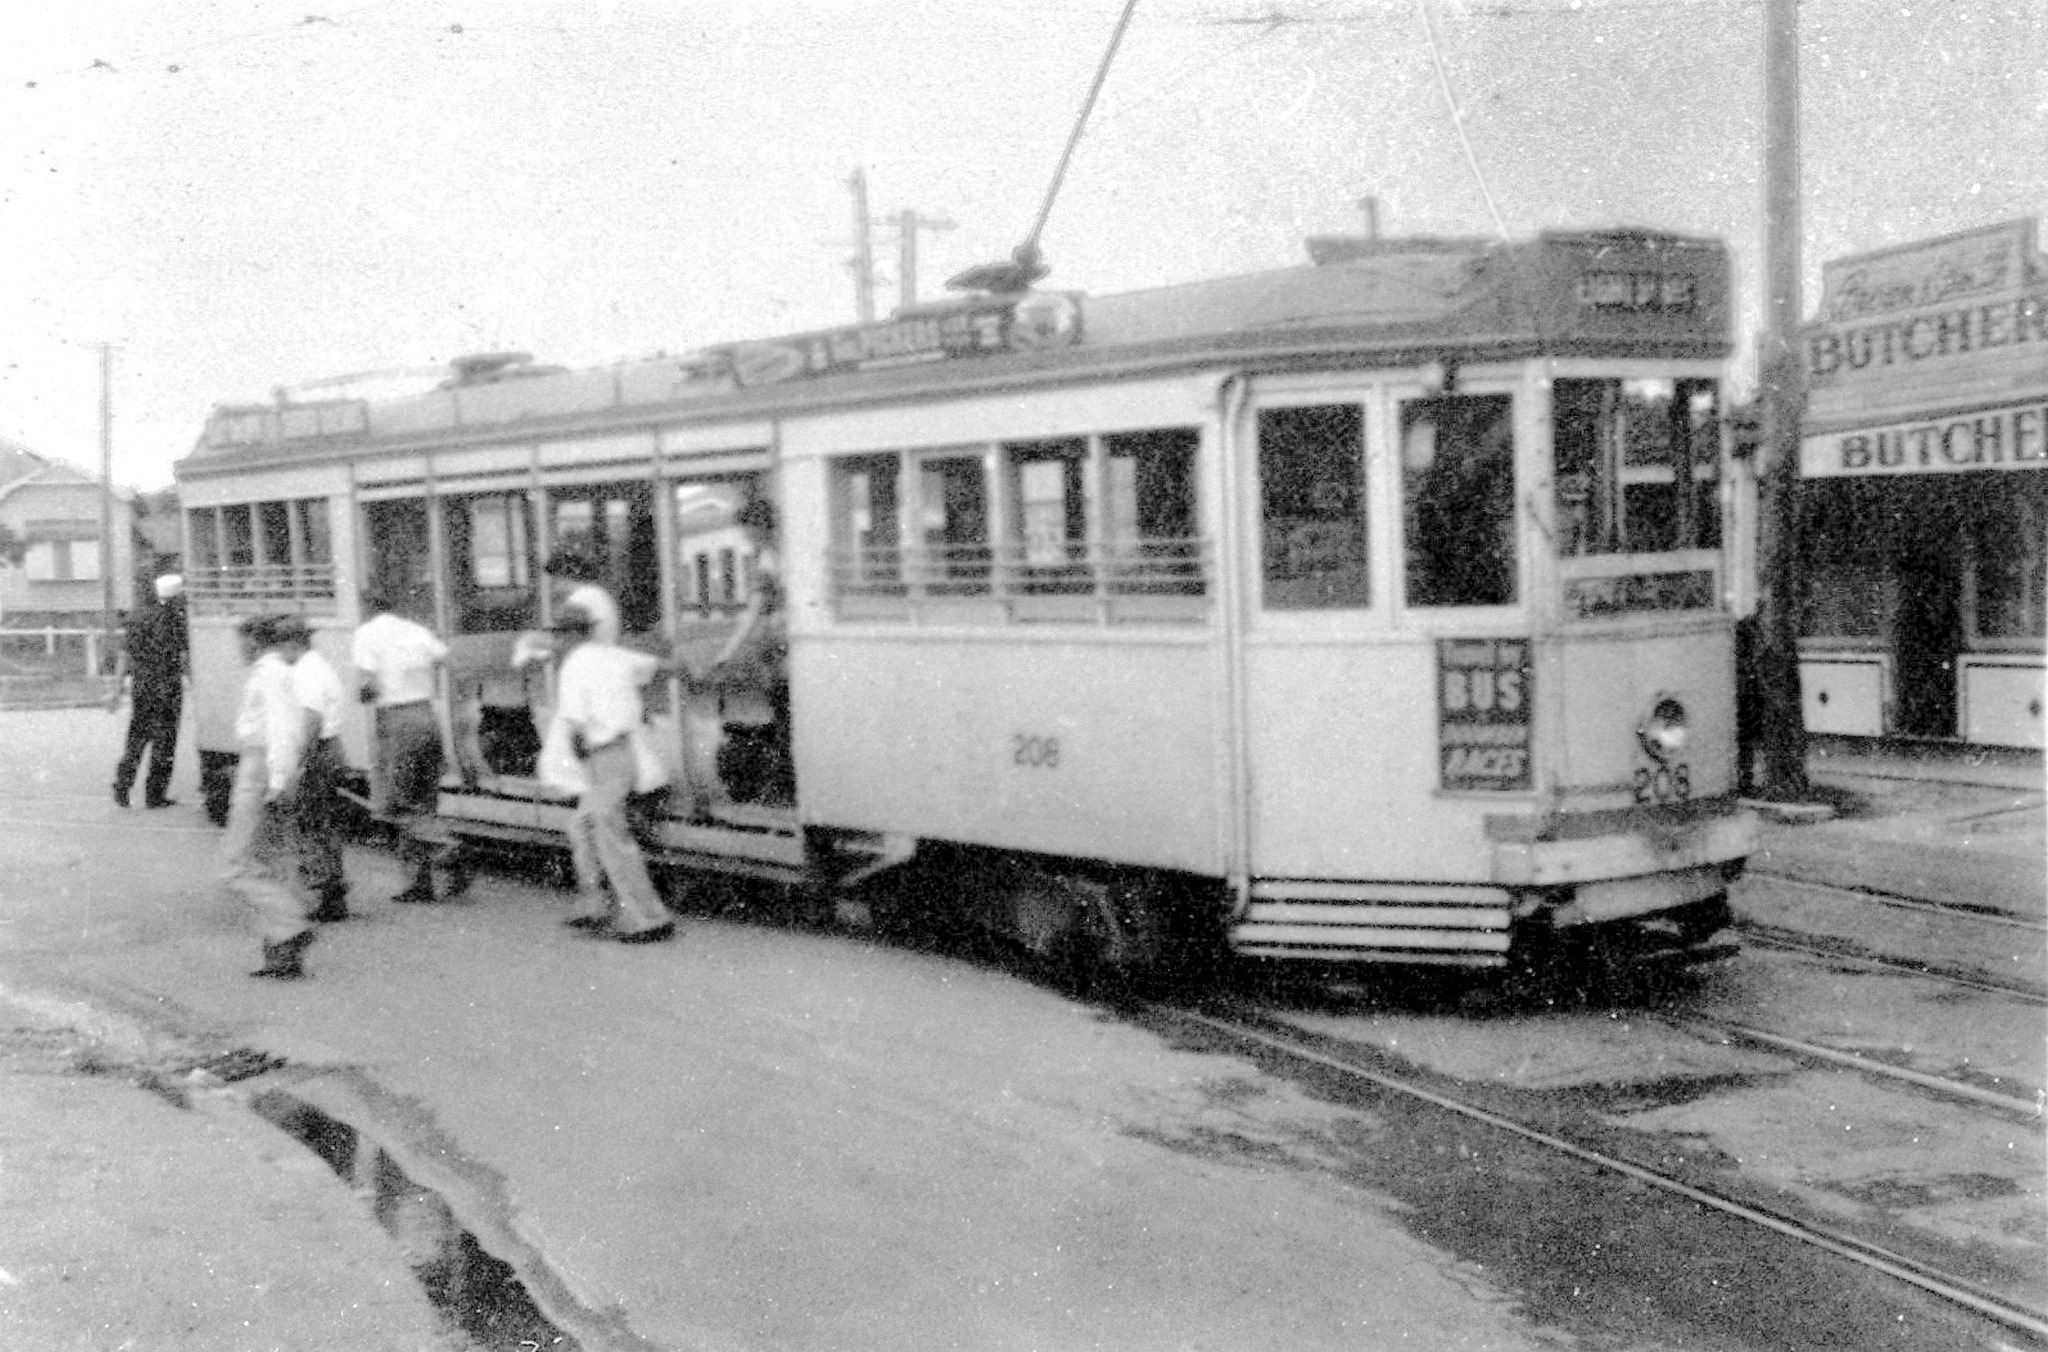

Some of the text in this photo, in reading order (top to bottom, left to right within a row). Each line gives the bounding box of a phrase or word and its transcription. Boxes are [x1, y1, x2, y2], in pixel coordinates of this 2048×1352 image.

[1810, 298, 2048, 376] BUTCHER
[1841, 406, 2048, 468] BUTCHE
[1444, 670, 1522, 711] BUS
